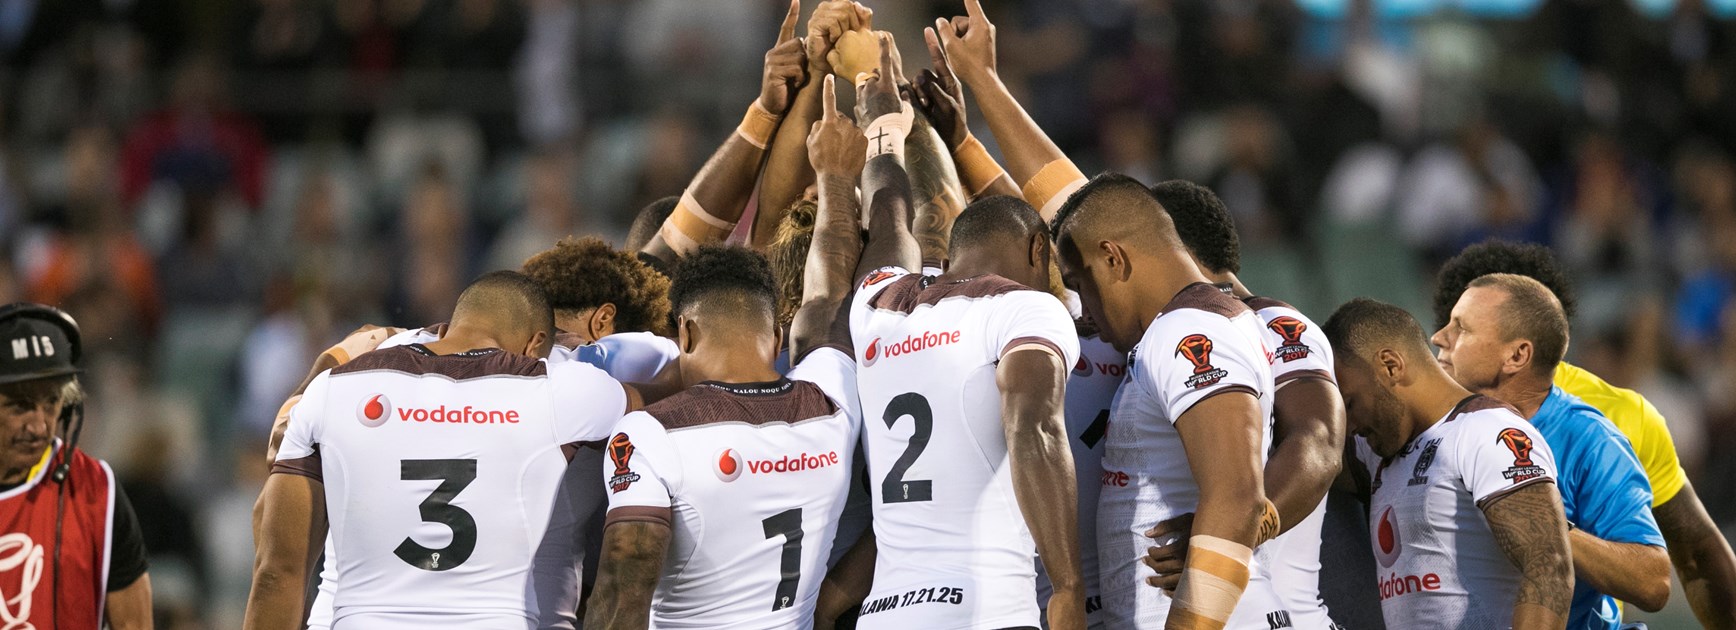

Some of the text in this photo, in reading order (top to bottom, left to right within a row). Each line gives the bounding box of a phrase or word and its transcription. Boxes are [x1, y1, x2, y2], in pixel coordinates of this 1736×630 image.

[884, 330, 961, 358] vodafone
[1284, 351, 1307, 361] 2017
[1212, 370, 1227, 379] CUP
[398, 405, 519, 424] vodafone
[882, 392, 933, 504] 2
[747, 451, 838, 474] vodafone
[393, 459, 477, 572] 3
[762, 507, 804, 612] 1
[900, 587, 963, 608] 17.21.25
